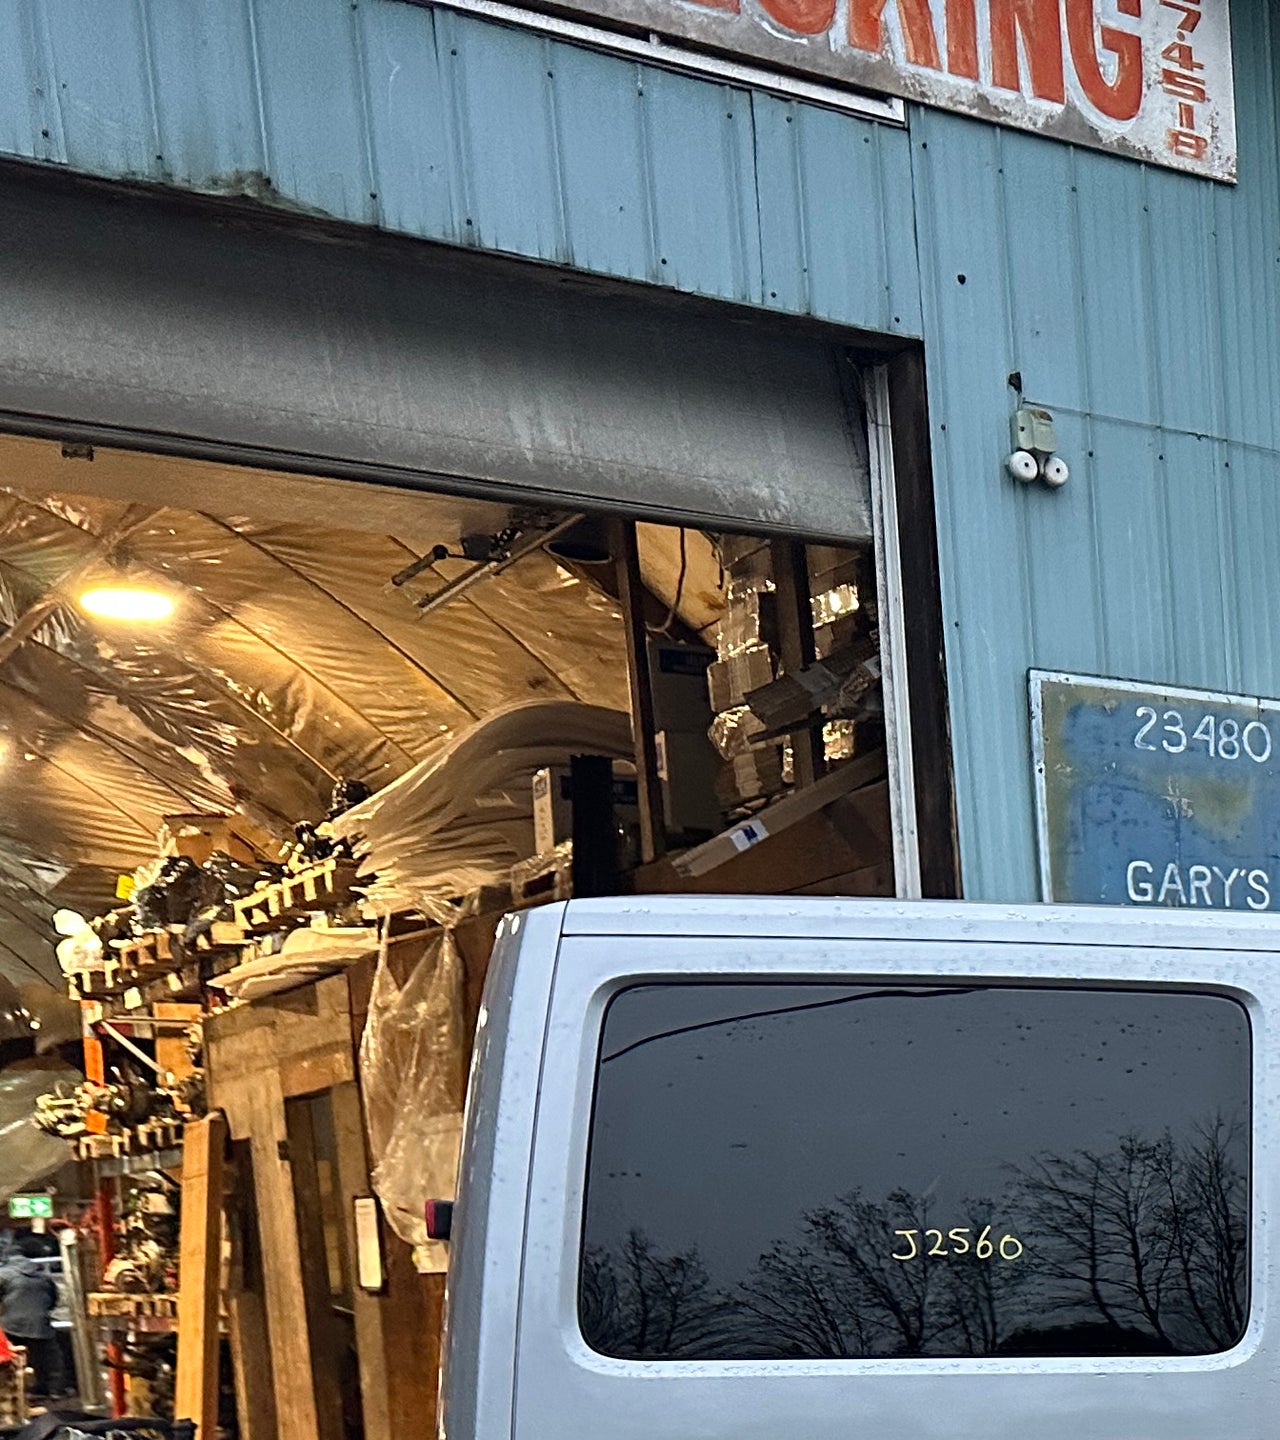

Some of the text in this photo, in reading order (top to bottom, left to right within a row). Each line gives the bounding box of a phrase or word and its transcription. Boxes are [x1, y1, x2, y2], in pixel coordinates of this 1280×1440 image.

[1133, 705, 1272, 763] 23480
[1126, 860, 1271, 911] GARY'S
[891, 1224, 1023, 1261] J2560
